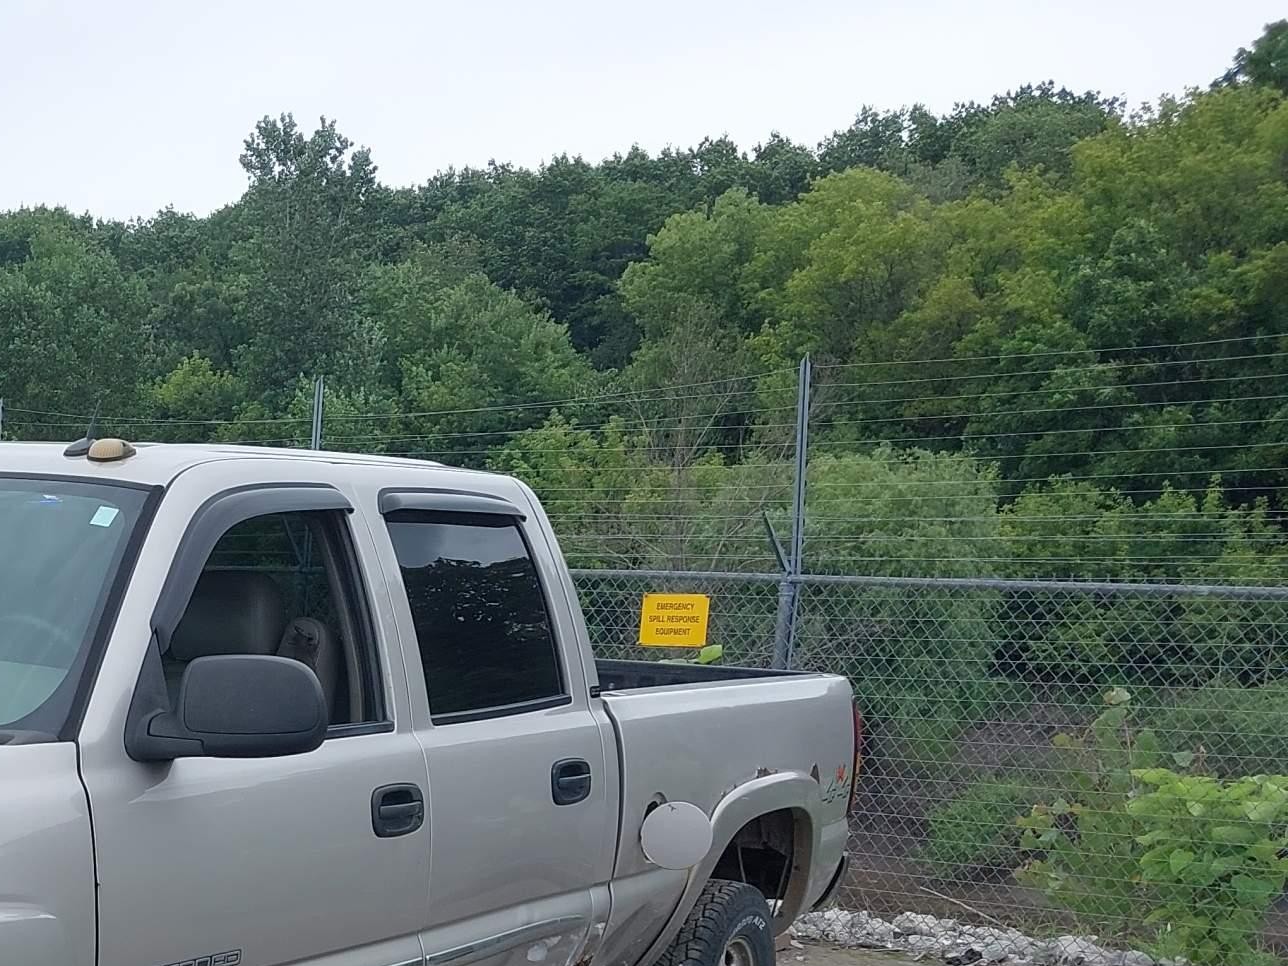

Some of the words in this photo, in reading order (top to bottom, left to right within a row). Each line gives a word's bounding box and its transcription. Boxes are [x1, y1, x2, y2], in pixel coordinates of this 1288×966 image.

[655, 602, 695, 611] EMERGENCY
[648, 615, 665, 623] SPILL
[666, 615, 700, 623] RESPONSE
[655, 627, 691, 636] EQUIPMENT
